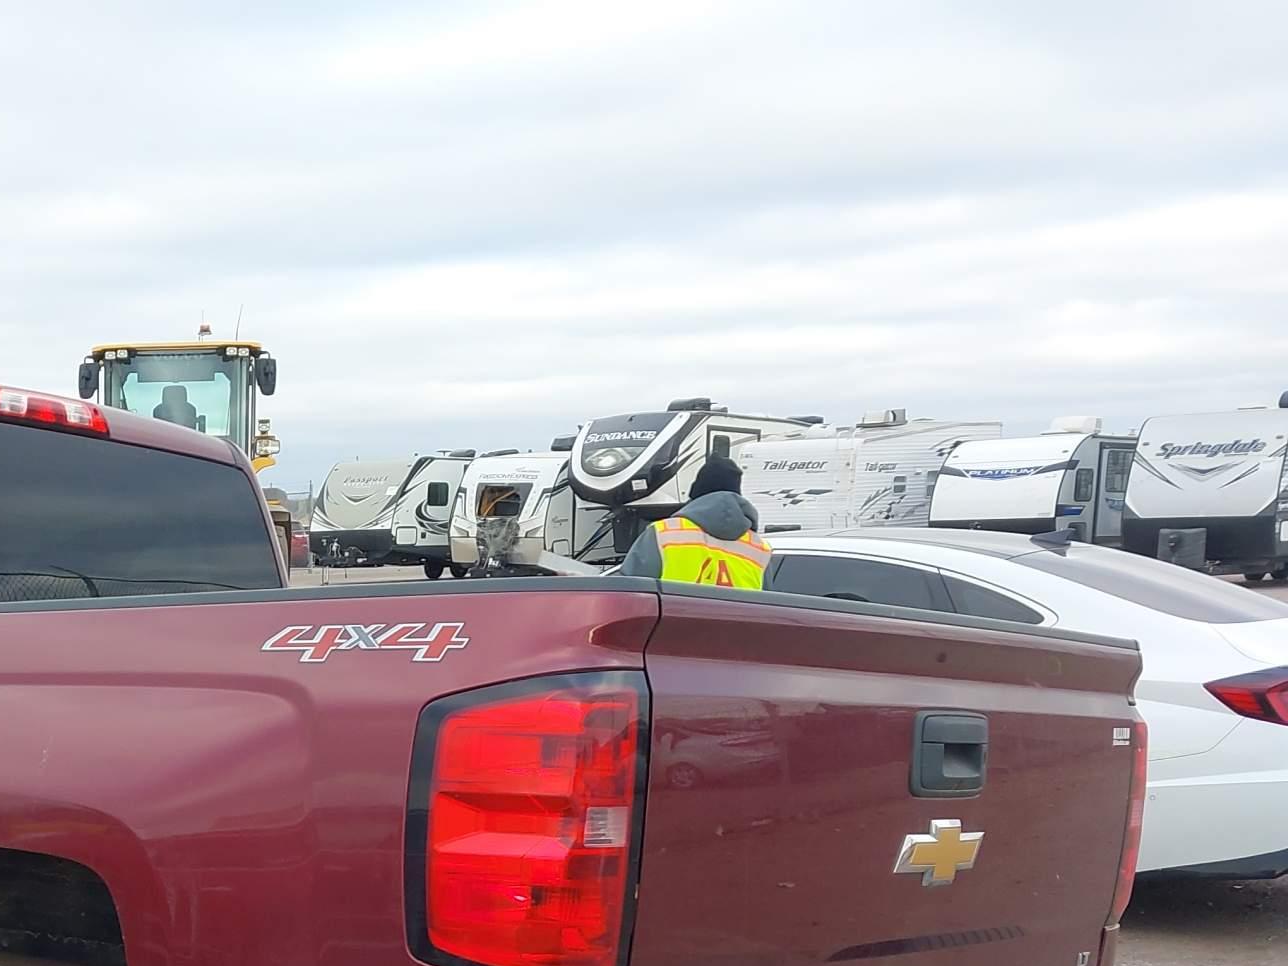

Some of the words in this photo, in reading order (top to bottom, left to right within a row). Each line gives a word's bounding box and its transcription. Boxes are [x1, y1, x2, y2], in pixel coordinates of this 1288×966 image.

[584, 430, 657, 444] SUNDANCE
[1155, 439, 1267, 459] Springdale
[763, 461, 828, 471] Tail-gator
[968, 468, 1035, 477] PLATINUM
